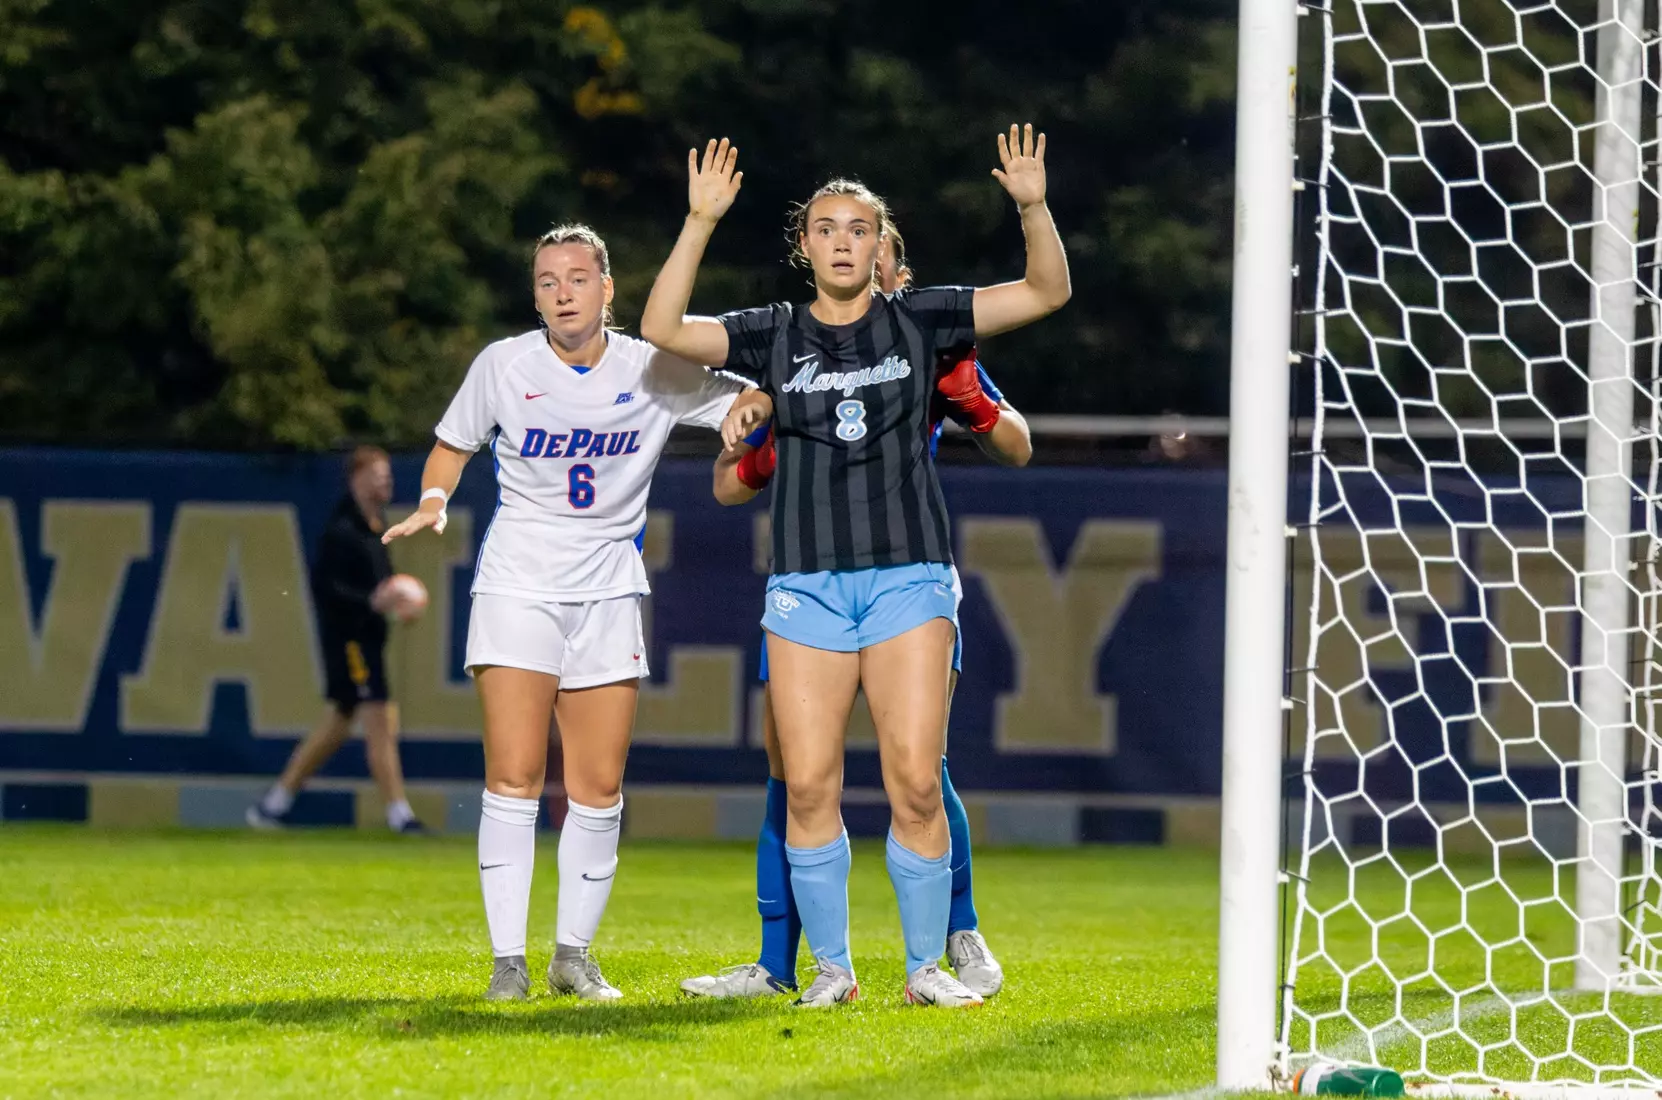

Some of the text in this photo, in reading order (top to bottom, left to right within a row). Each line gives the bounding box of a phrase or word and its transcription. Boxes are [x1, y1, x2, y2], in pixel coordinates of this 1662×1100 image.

[782, 355, 911, 397] Marquette
[835, 399, 868, 441] 8
[567, 463, 595, 510] 6
[0, 495, 1163, 756] VALLY
